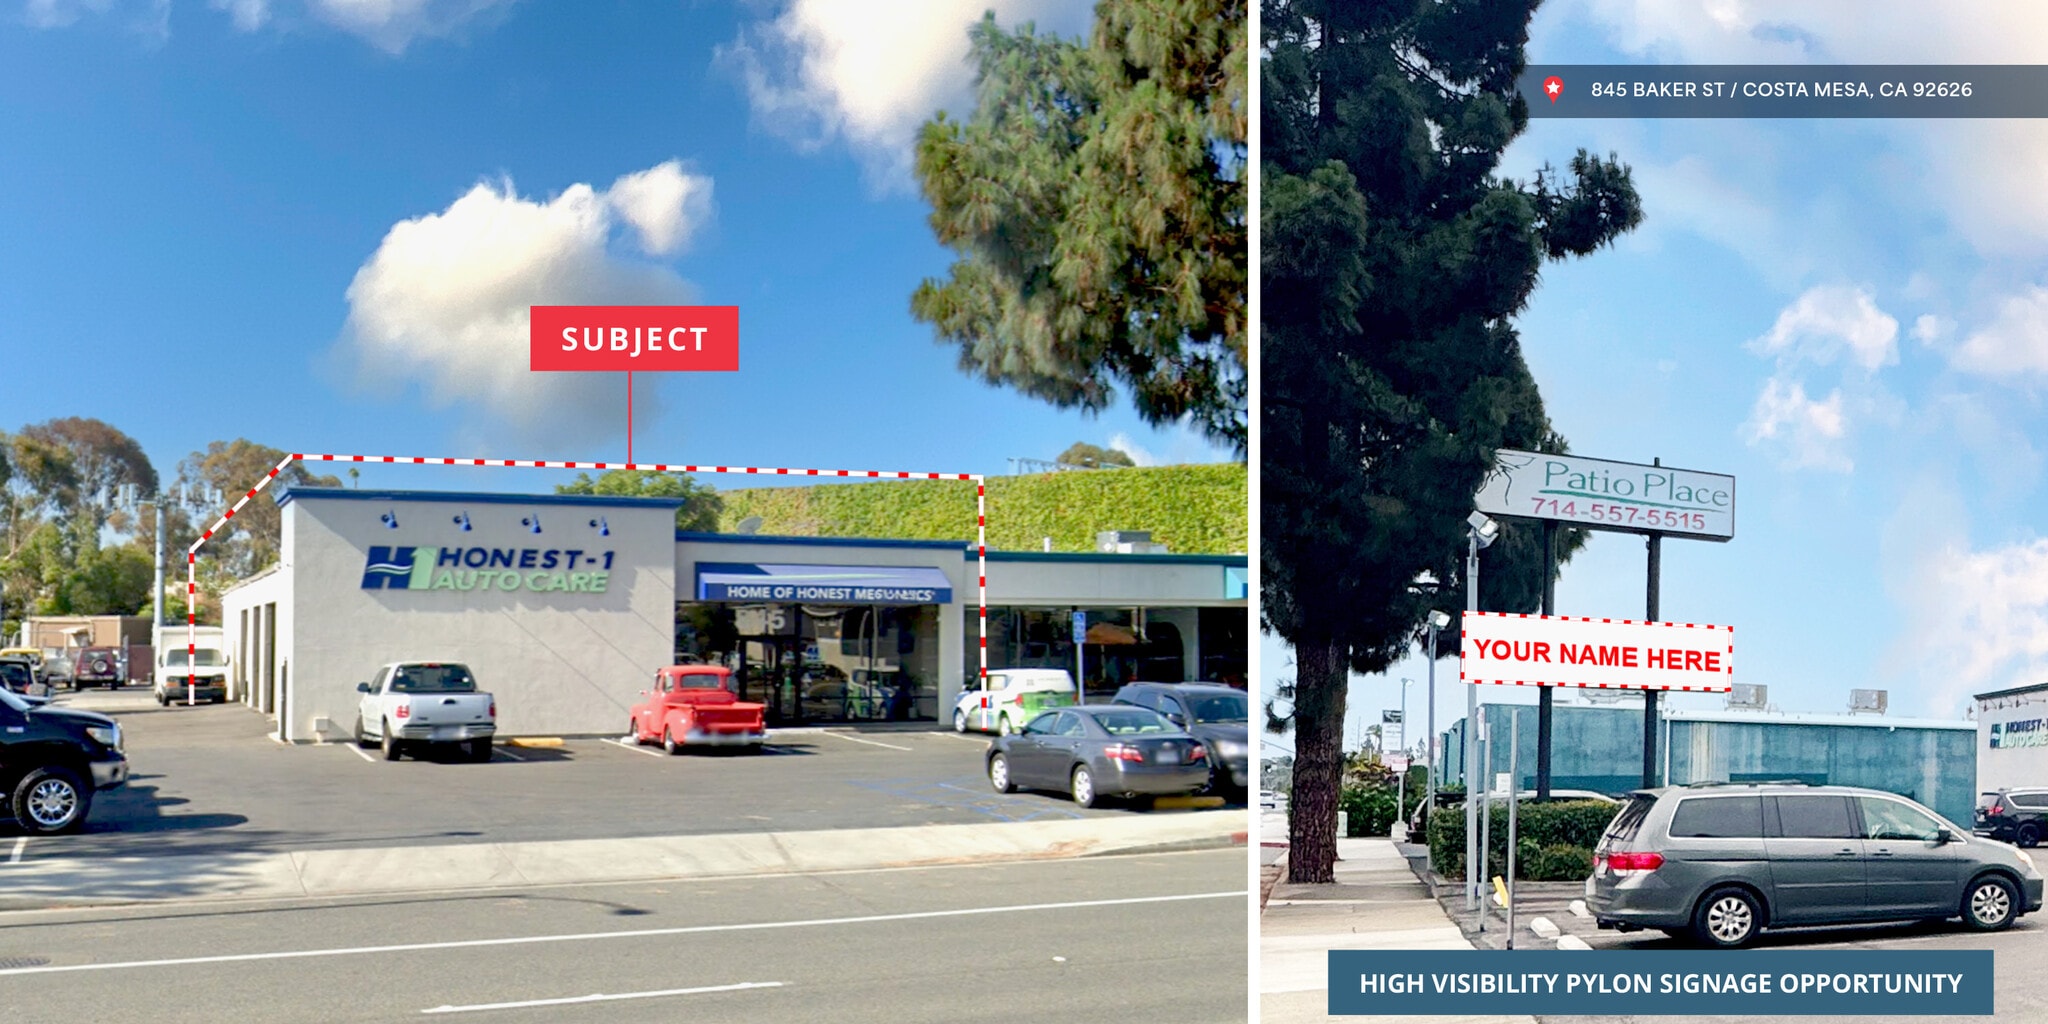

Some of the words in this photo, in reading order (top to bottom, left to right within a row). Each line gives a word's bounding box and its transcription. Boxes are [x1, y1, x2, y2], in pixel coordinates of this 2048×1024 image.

[1544, 461, 1635, 497] Patio
[1644, 472, 1730, 507] Place
[1531, 497, 1706, 531] 714-557-5515
[438, 547, 615, 570] HONEST-1
[431, 570, 521, 592] AUTO
[526, 571, 609, 593] CARE
[727, 586, 771, 599] HOME
[774, 586, 793, 599] OF
[797, 587, 852, 600] HONEST
